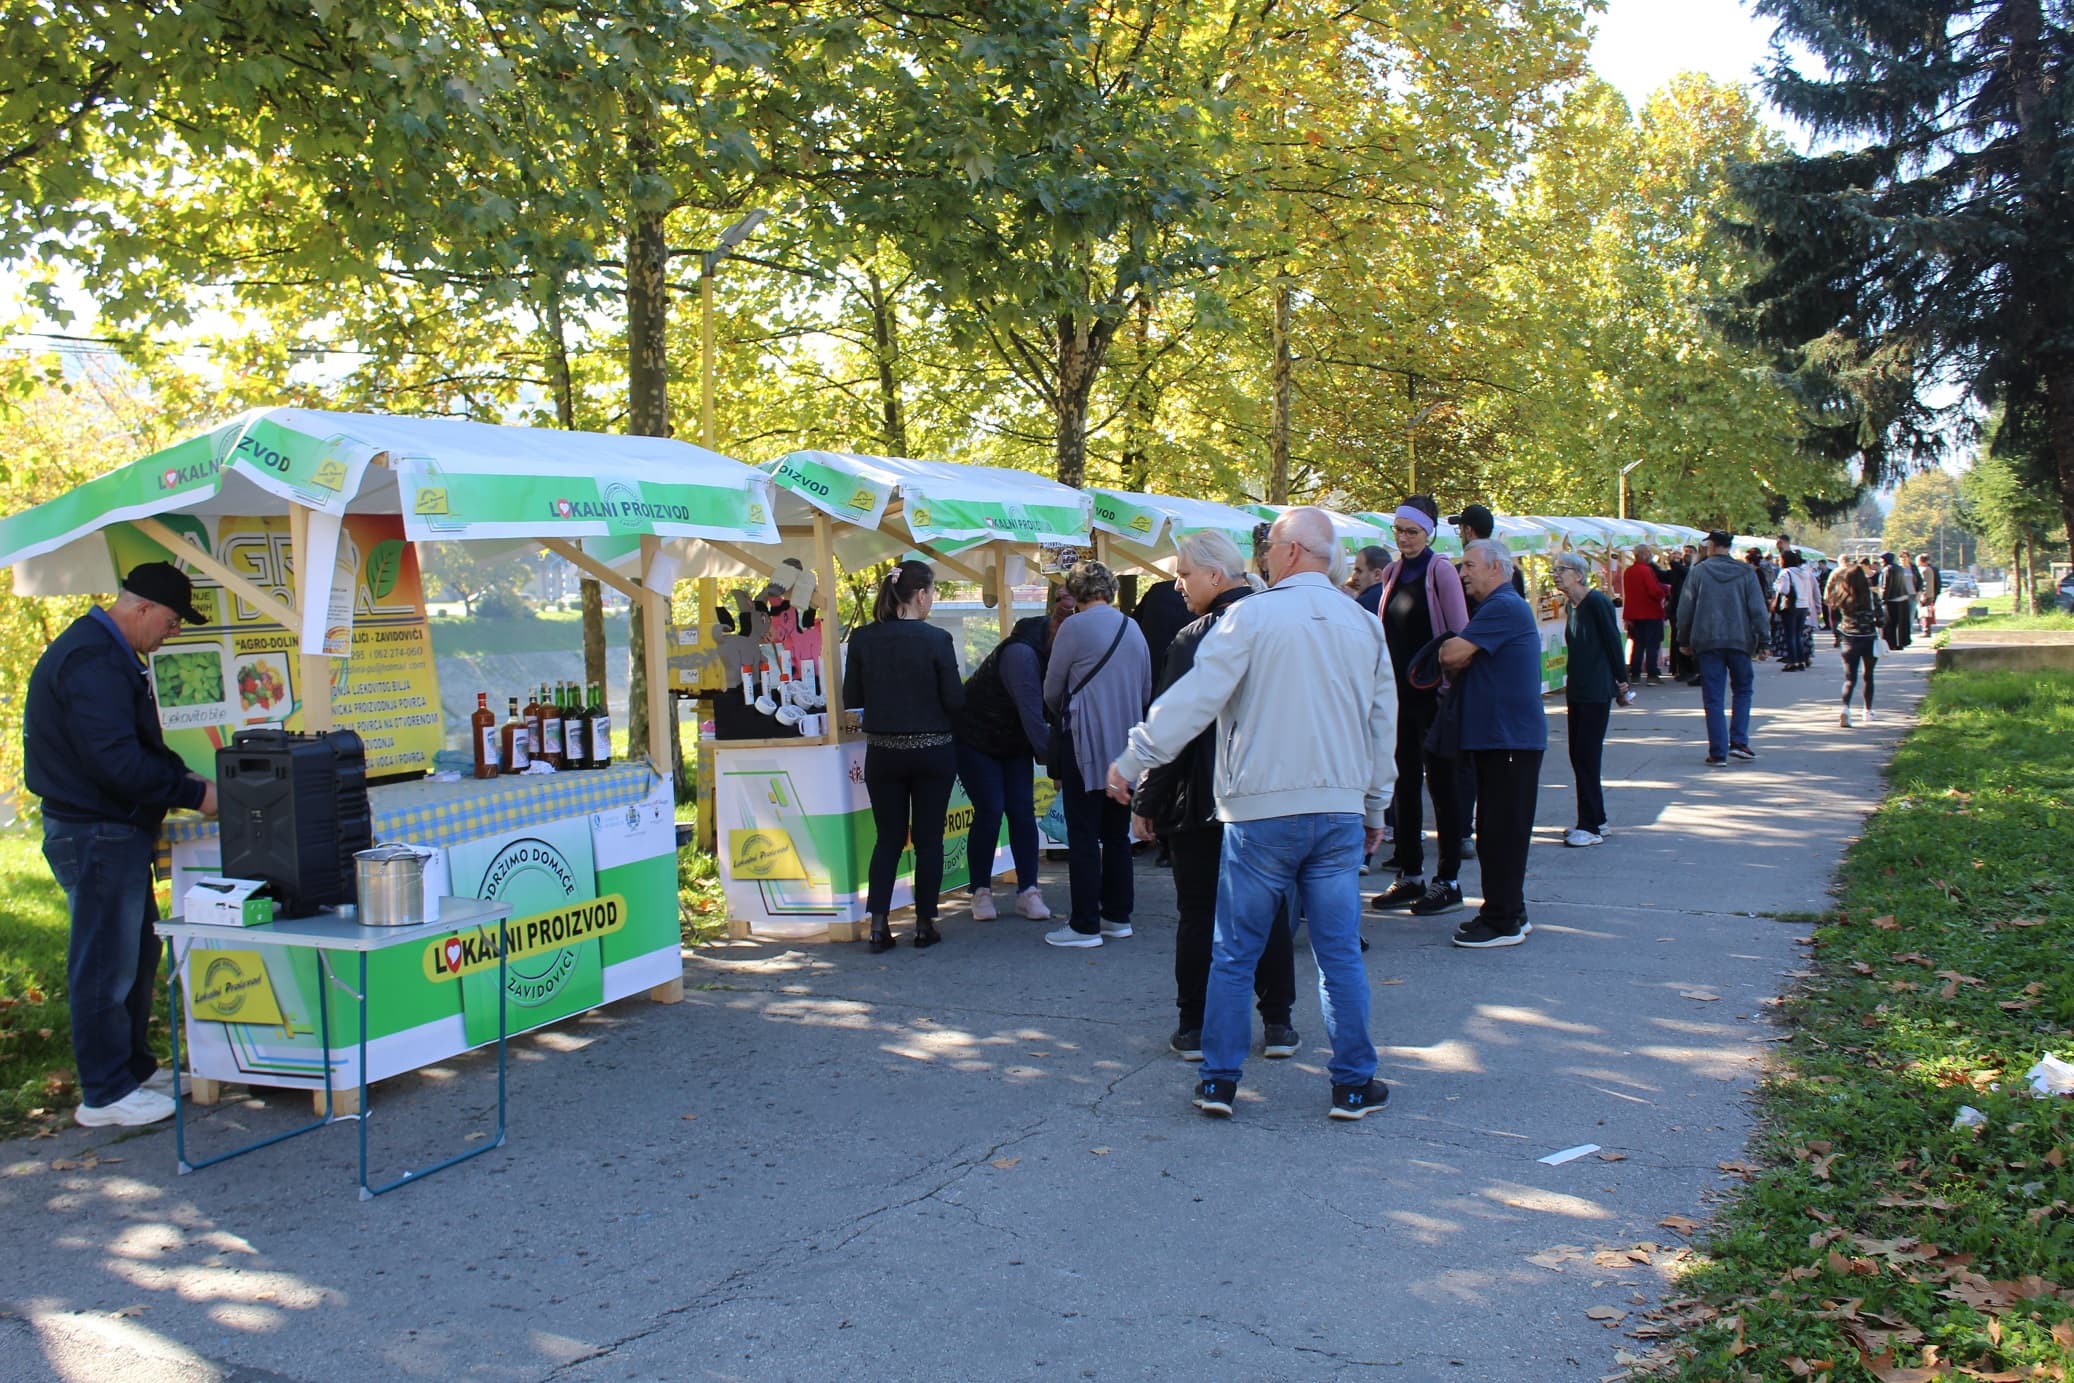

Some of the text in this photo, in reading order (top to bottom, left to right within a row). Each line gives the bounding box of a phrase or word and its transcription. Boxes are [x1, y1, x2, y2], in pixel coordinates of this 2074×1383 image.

[549, 498, 690, 520] LOKALNI PROIZVOD
[532, 848, 576, 897] DOMAĆE
[526, 900, 618, 949] PROIZVOD
